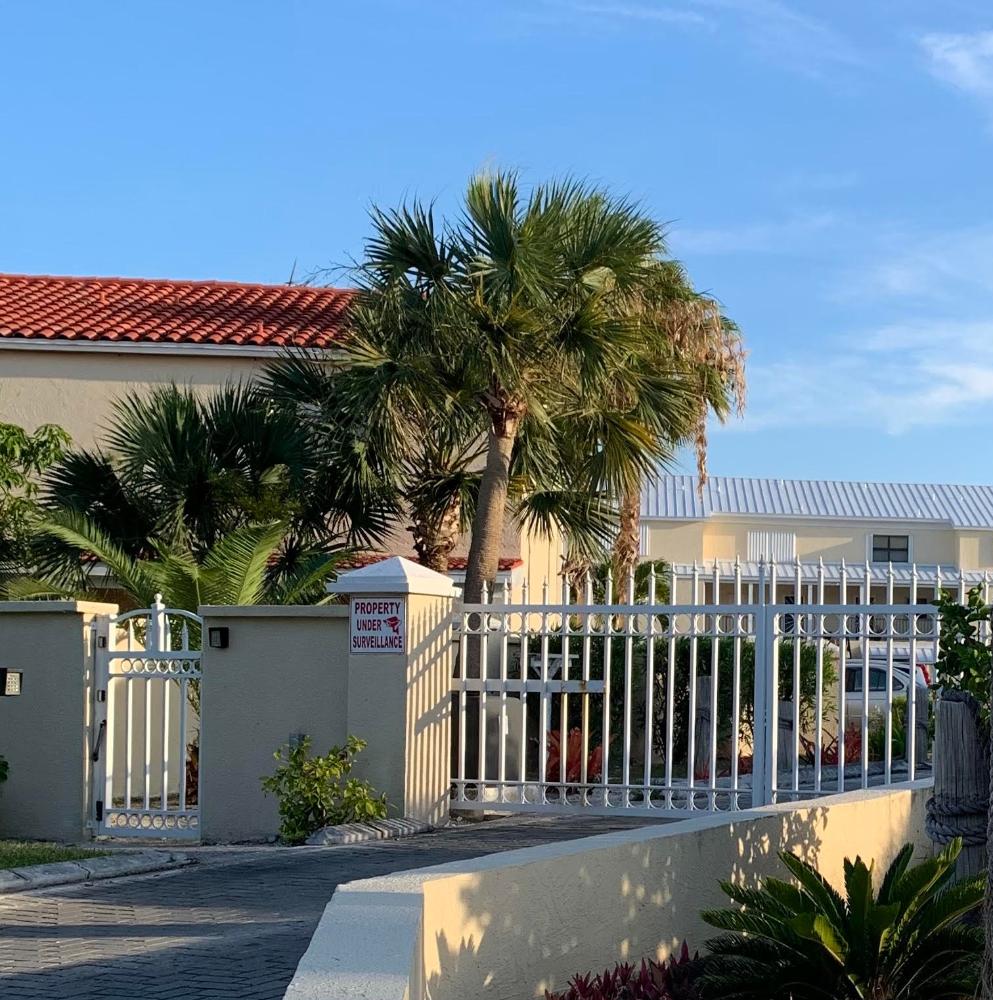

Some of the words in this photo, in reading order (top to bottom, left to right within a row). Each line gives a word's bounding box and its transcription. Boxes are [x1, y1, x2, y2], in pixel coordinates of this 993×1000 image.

[354, 602, 401, 615] PROPERTY
[356, 619, 382, 632] UNDER
[352, 635, 403, 649] SURVEILLANCE
